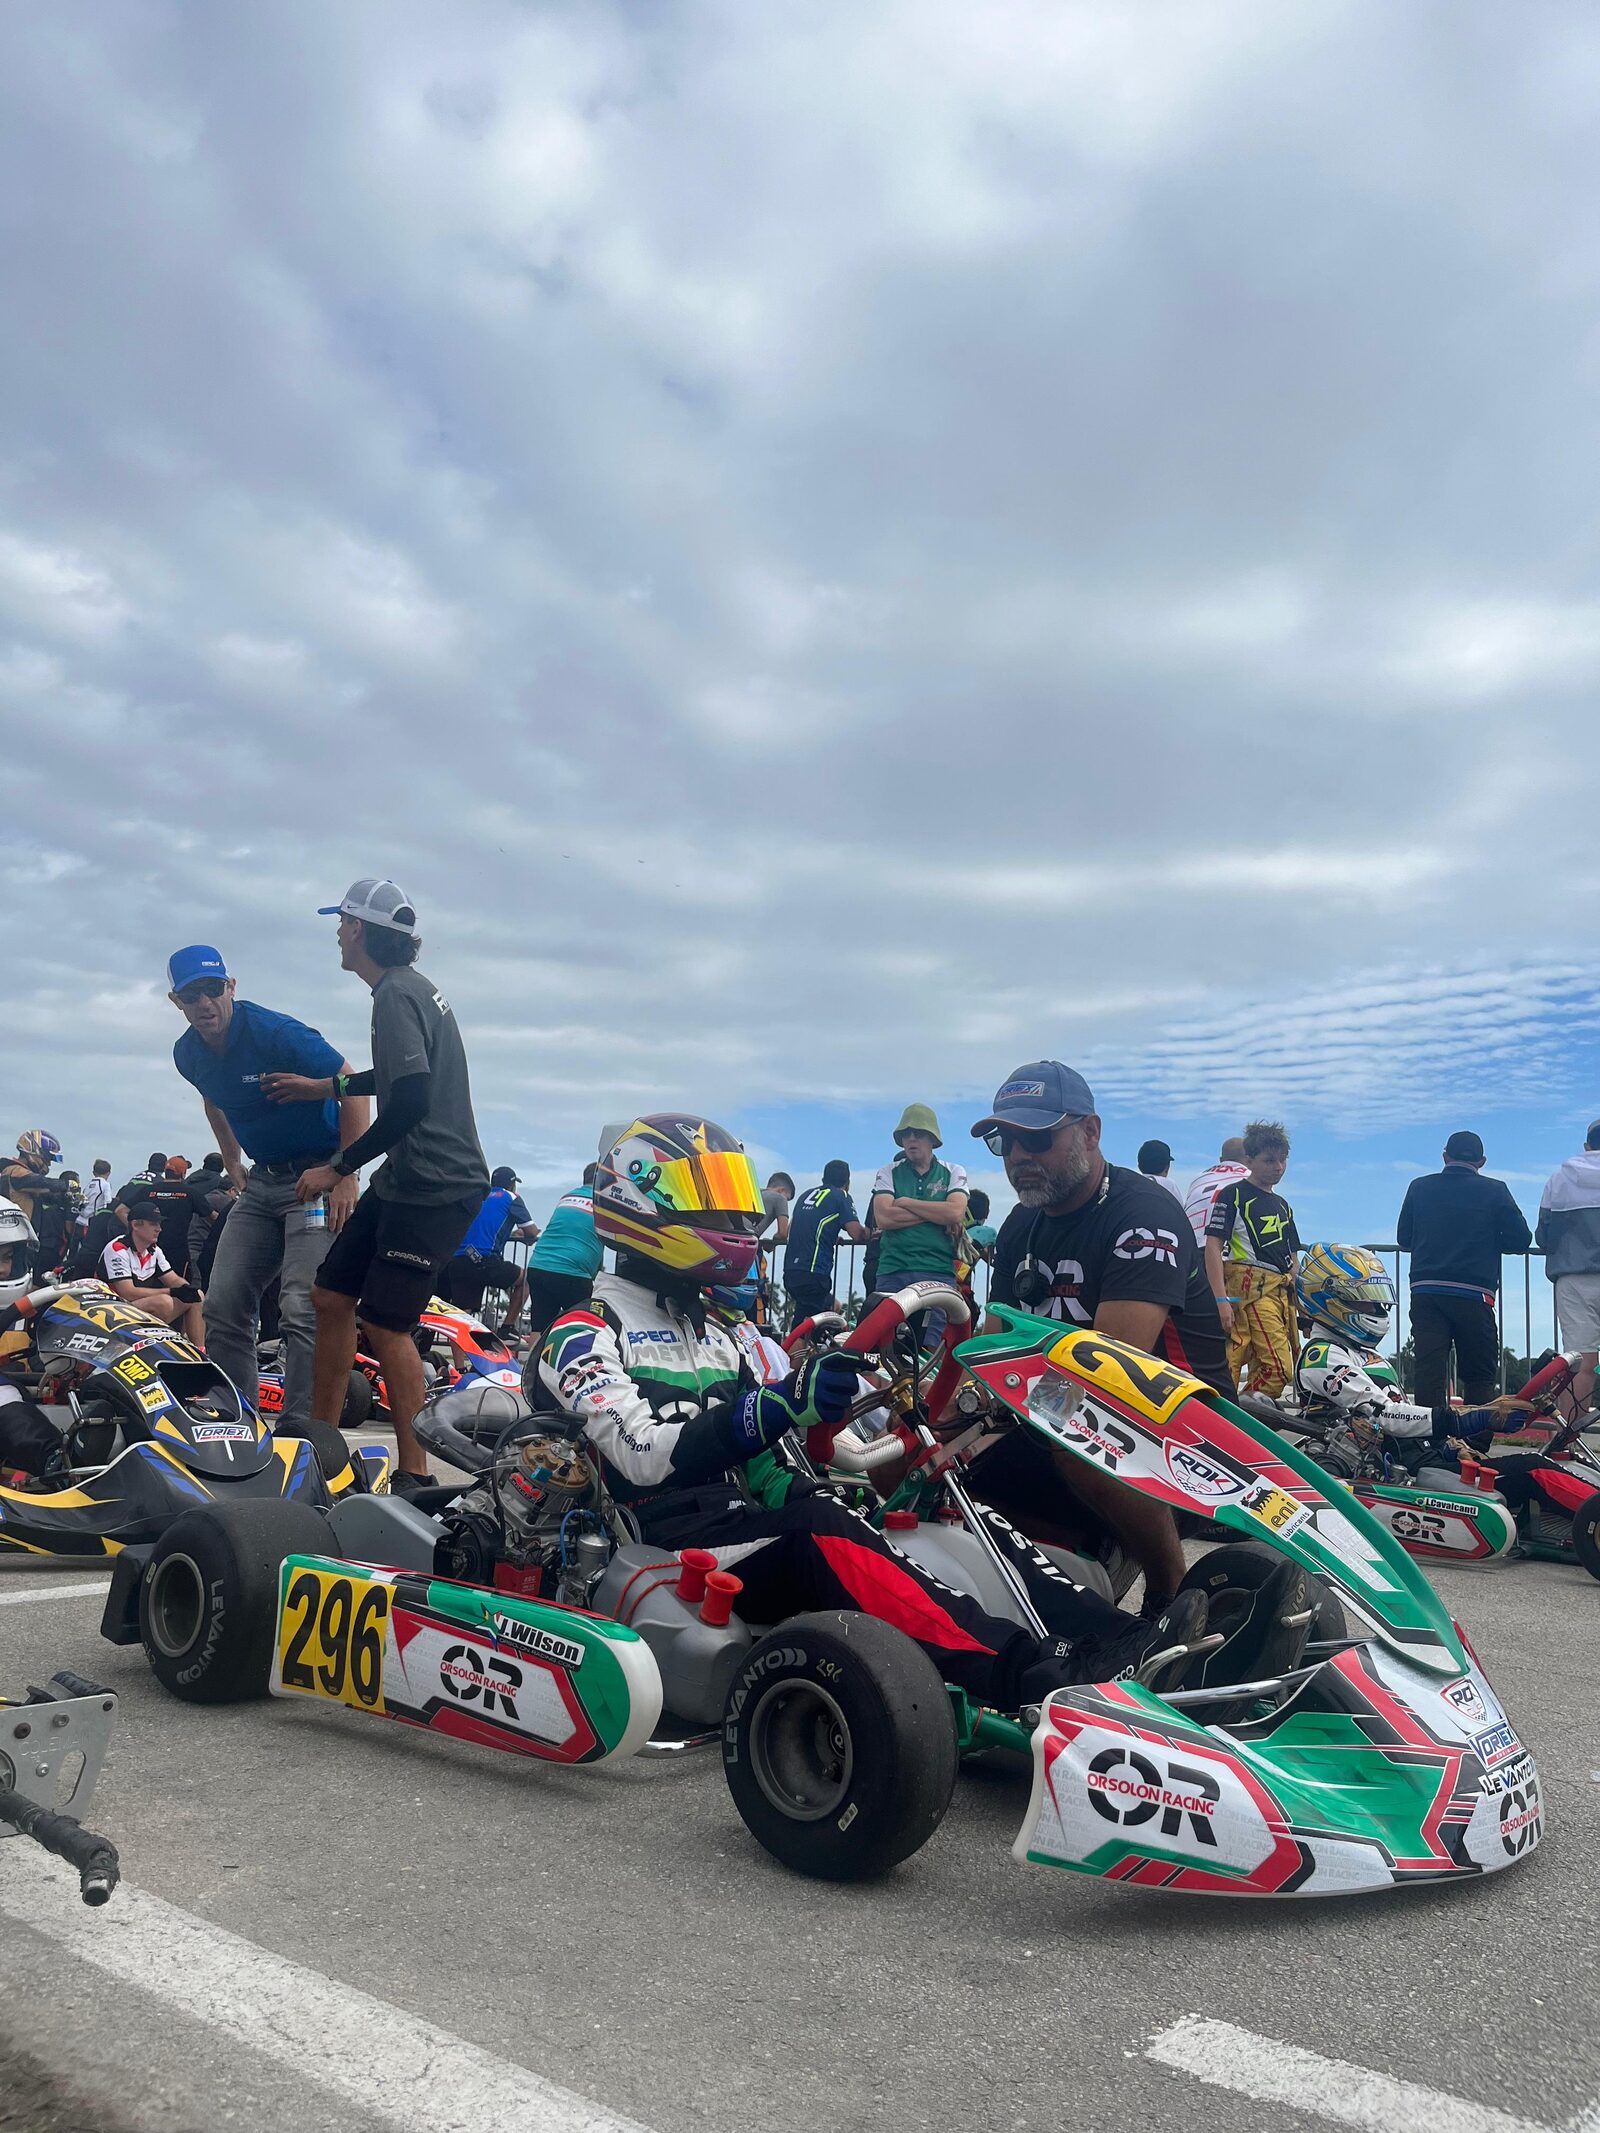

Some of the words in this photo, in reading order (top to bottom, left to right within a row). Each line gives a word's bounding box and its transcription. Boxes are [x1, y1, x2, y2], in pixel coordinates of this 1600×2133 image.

[119, 1357, 150, 1382] OMP
[743, 1390, 758, 1437] sparco
[1092, 1434, 1126, 1459] RACING
[1171, 1450, 1232, 1493] ROK
[1270, 1497, 1300, 1528] eni
[1282, 1510, 1311, 1539] lubricants
[1391, 1510, 1446, 1543] OR
[281, 1572, 388, 1707] 296
[440, 1661, 483, 1685] ORSOLON
[482, 1677, 518, 1698] RACING
[440, 1644, 523, 1721] OR
[726, 1647, 802, 1764] LEVANTO
[1469, 1722, 1516, 1766] VORTEX
[1087, 1772, 1161, 1802] ORSOLON
[1161, 1790, 1215, 1816] RACING
[1087, 1747, 1221, 1847] OR
[1500, 1812, 1528, 1835] ORSOLON
